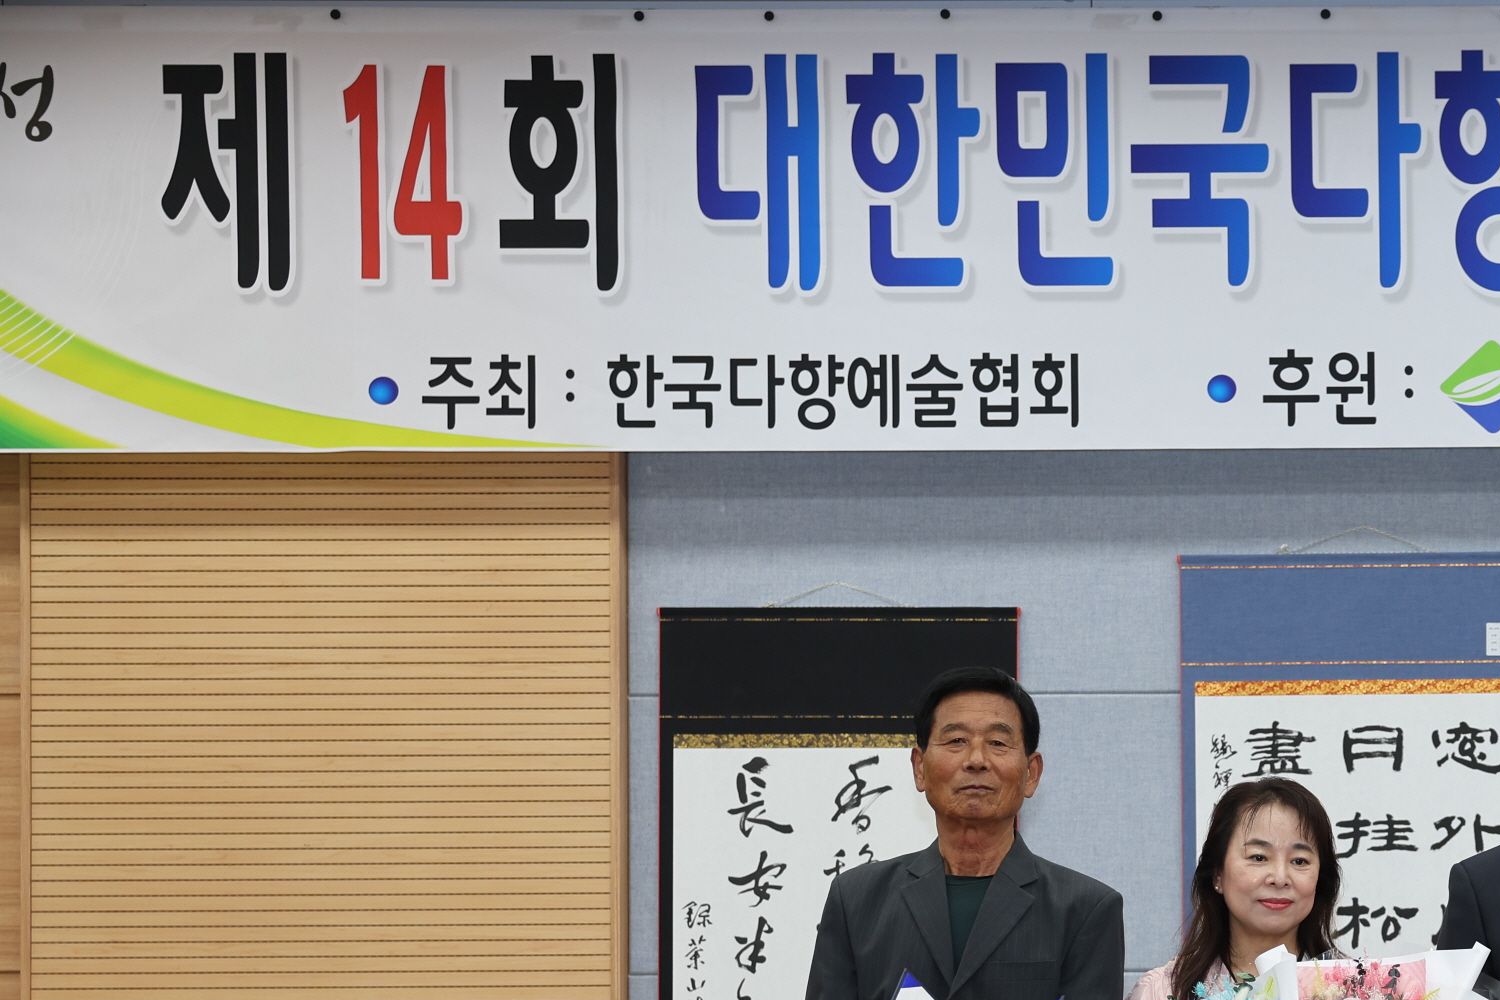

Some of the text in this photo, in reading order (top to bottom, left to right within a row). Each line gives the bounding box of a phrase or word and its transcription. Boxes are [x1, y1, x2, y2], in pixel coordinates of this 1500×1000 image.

[421, 354, 537, 430] 주최
[607, 352, 1079, 430] 한국다향예술협회
[1262, 349, 1377, 427] 후원
